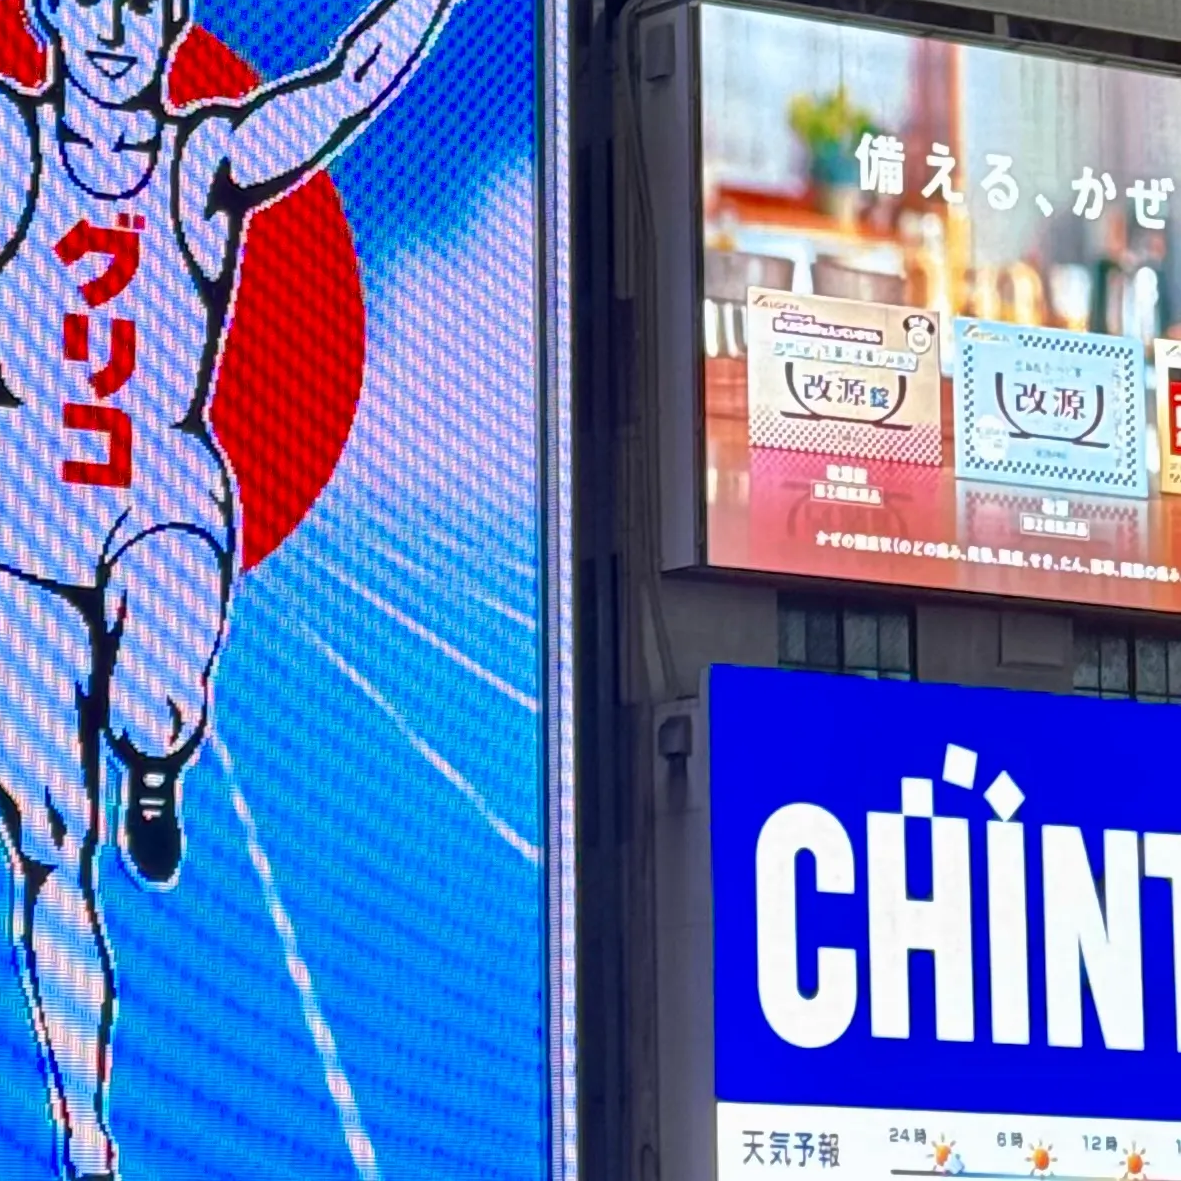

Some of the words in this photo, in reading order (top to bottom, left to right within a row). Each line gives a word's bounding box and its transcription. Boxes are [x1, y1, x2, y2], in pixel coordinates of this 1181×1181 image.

[54, 212, 146, 488] グリコ
[742, 1129, 841, 1168] 天気予報
